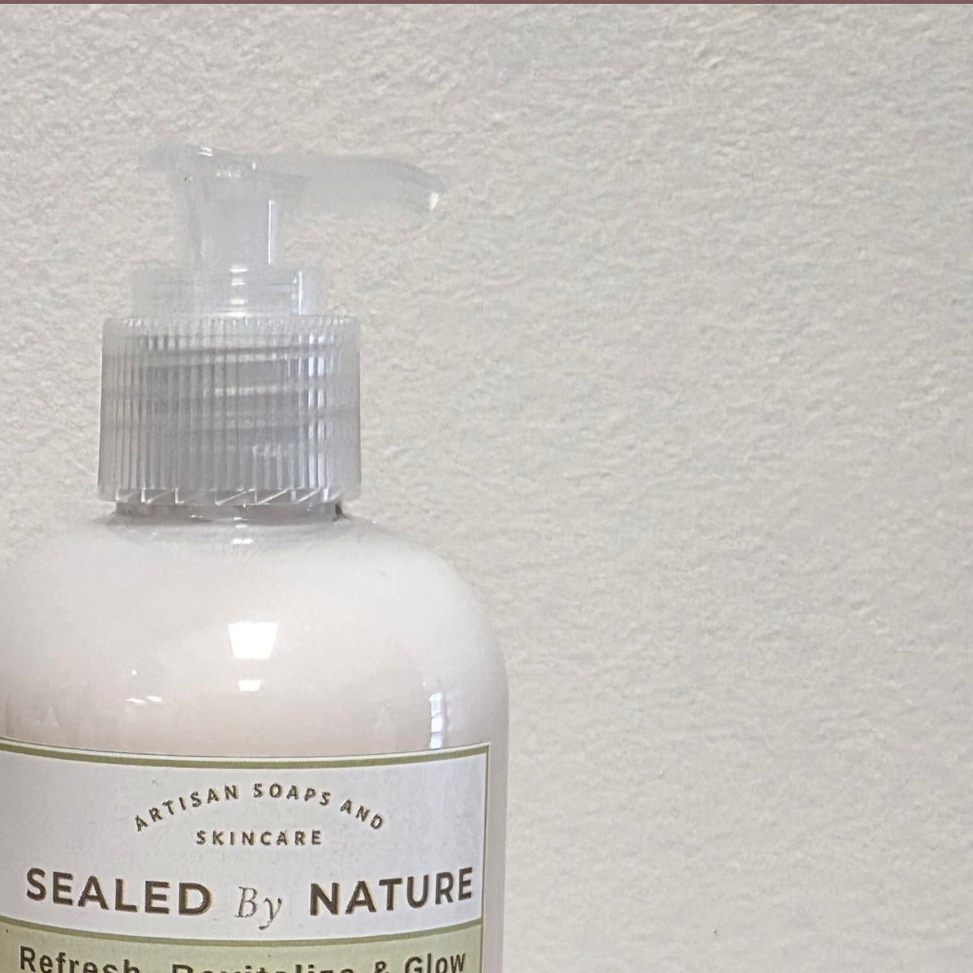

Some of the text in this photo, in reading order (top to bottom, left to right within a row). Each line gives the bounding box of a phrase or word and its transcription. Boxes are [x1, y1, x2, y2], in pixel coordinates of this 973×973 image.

[134, 782, 386, 833] ARTISAN SOAPS AND
[195, 829, 323, 846] SKINCARE
[25, 866, 473, 930] SEALED By NATURE
